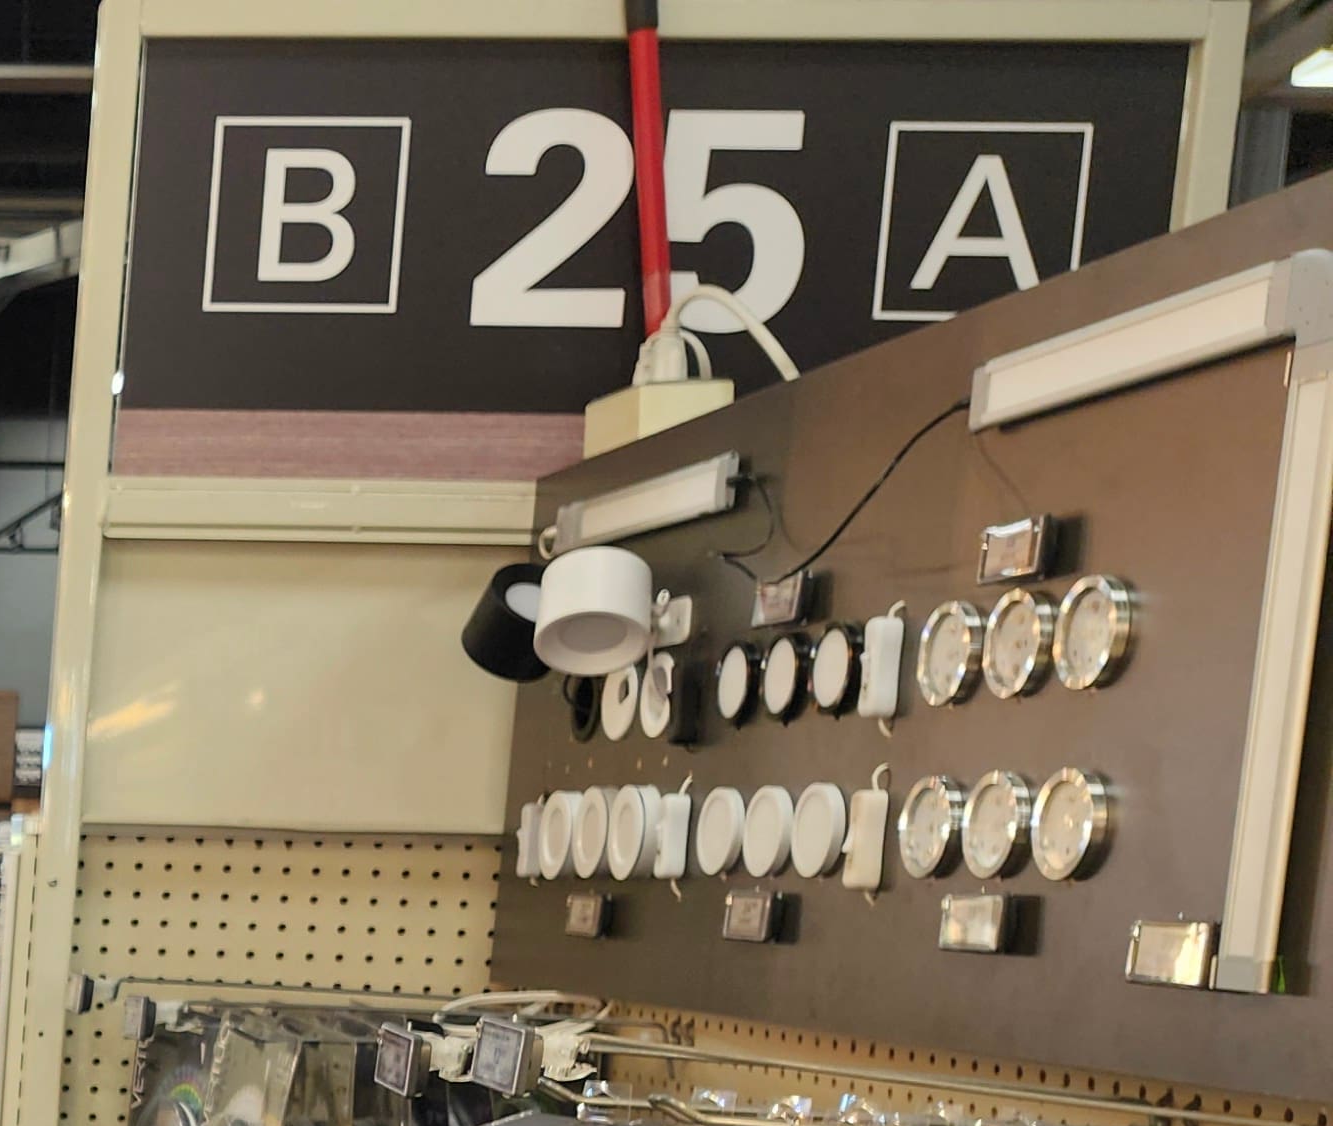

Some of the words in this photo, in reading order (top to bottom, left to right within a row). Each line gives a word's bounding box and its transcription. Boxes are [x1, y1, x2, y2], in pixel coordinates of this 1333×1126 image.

[256, 147, 359, 283] B
[470, 107, 808, 335] 25
[909, 154, 1042, 293] A
